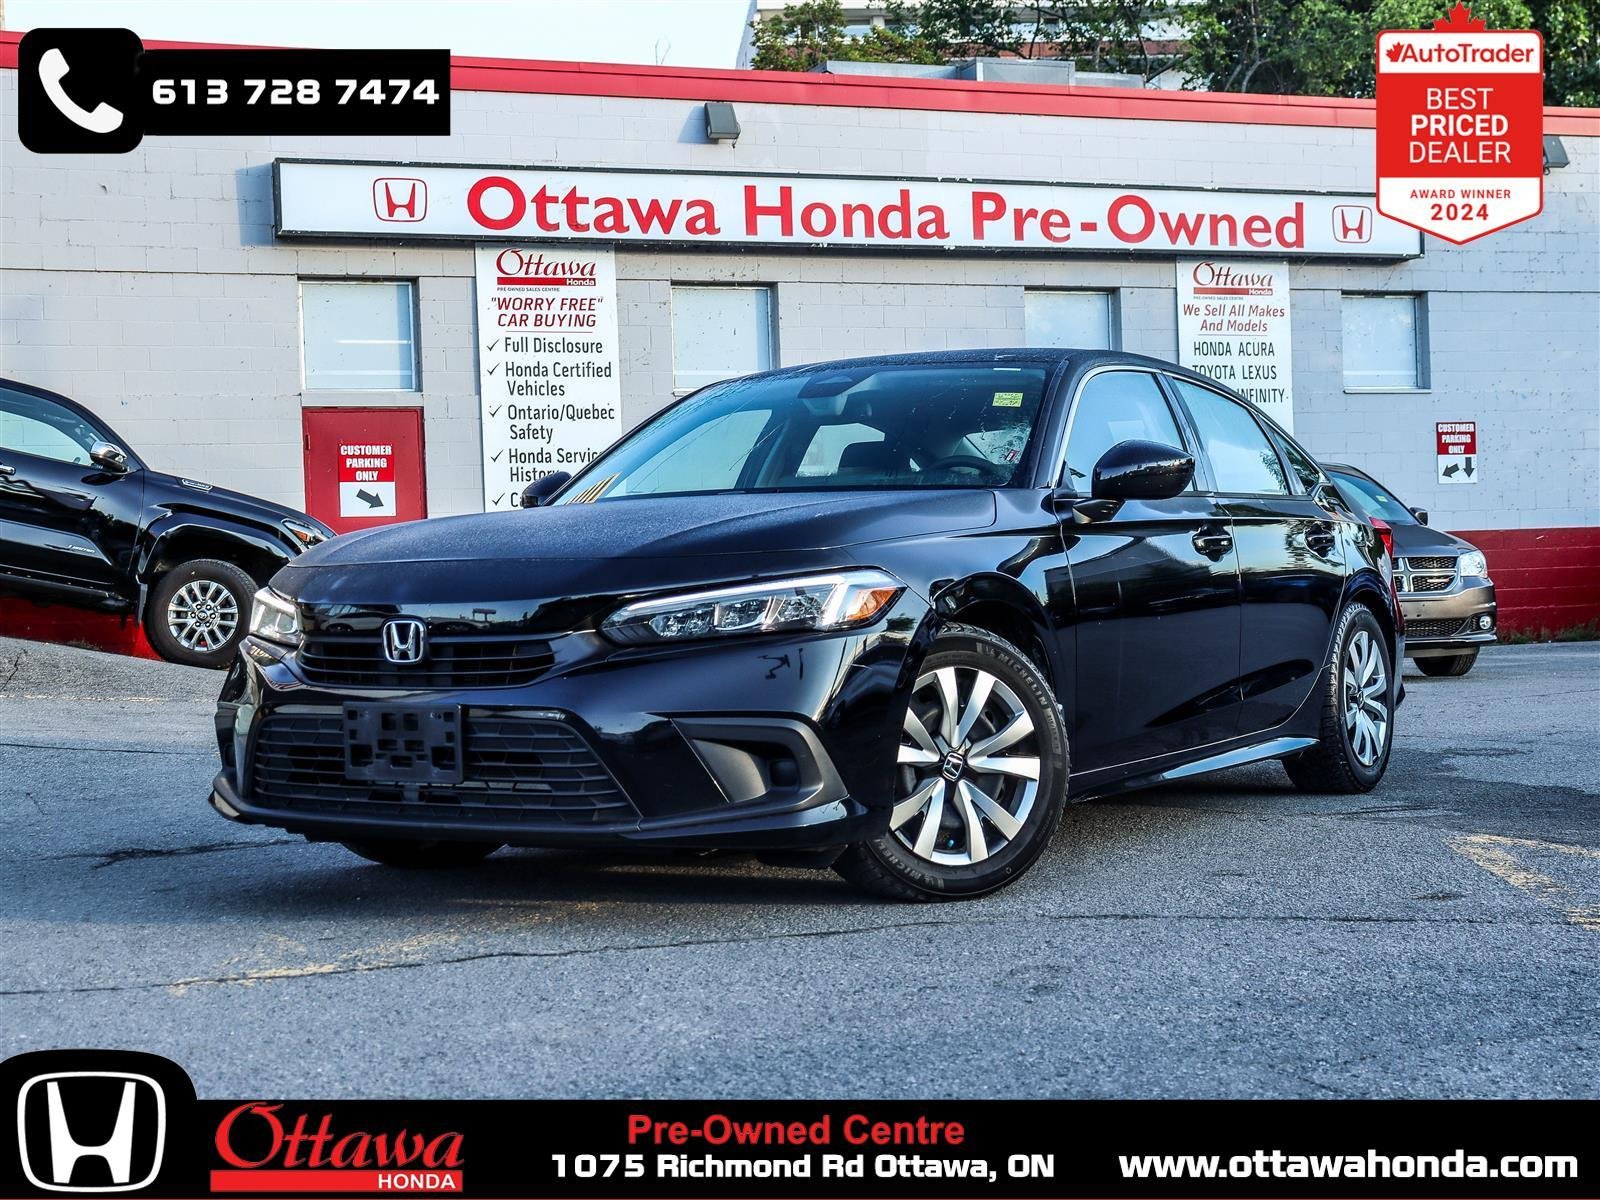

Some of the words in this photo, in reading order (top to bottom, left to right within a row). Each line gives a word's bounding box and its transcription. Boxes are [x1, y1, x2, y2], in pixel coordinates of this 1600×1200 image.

[467, 176, 721, 236] Ottawa
[744, 185, 950, 240] Honda
[971, 190, 1305, 249] Pre-Owned
[496, 248, 597, 276] Ottawa
[1193, 260, 1273, 287] Ottawa
[566, 278, 595, 287] Honda
[492, 297, 556, 311] "WORRY
[560, 297, 603, 311] FREE"
[1183, 303, 1200, 316] We
[1204, 304, 1226, 317] Sell
[1229, 305, 1245, 317] All
[1248, 305, 1285, 317] Makes
[497, 313, 529, 327] CAR
[534, 313, 597, 327] BUYING
[1200, 319, 1223, 332] And
[1227, 319, 1268, 332] Models
[504, 336, 528, 353] Full
[533, 337, 603, 354] Disclosure
[1193, 341, 1232, 356] HONDA
[1238, 342, 1275, 357] ACURA
[505, 362, 549, 378] Honda
[552, 361, 612, 378] Certified
[1242, 365, 1277, 380] LEXUS
[507, 380, 565, 396] Vehicles
[507, 404, 615, 421] Ontario/Quebec
[509, 424, 553, 444] Safety
[1437, 423, 1475, 433] CUSTOMER
[1441, 434, 1471, 443] PARKING
[340, 445, 392, 456] CUSTOMER
[508, 447, 552, 464] Honda
[556, 447, 601, 463] Servic
[1448, 445, 1465, 454] ONLY
[345, 457, 388, 468] PARKING
[355, 470, 379, 481] ONLY
[509, 466, 559, 482] Histor
[998, 652, 1049, 708] MICHELIN
